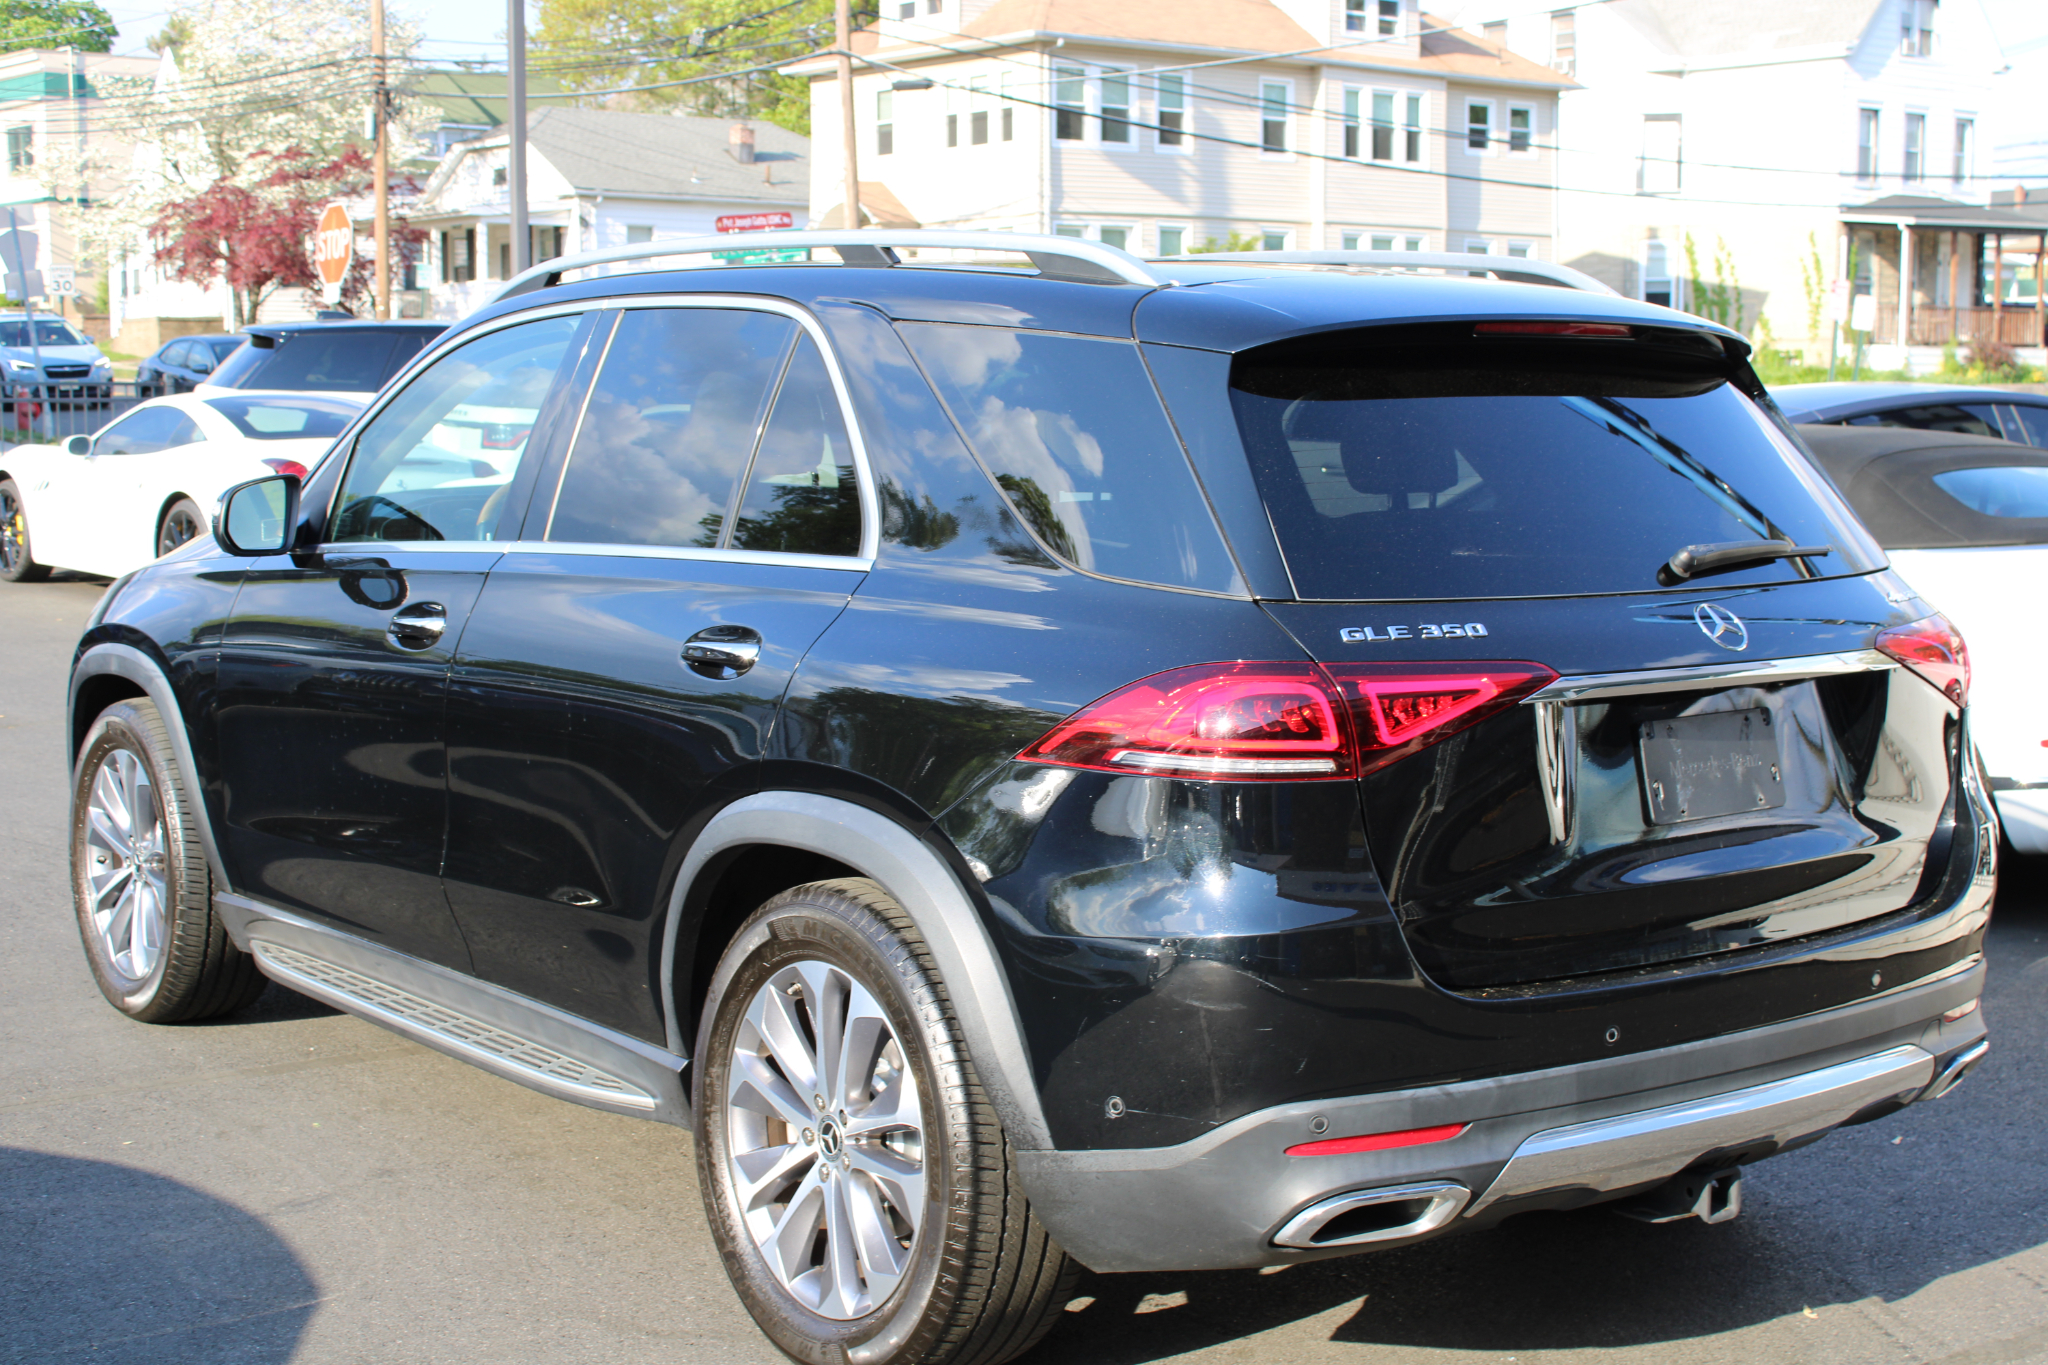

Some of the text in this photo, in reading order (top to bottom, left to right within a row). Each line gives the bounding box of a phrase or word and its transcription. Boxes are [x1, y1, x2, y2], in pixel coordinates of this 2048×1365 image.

[318, 227, 350, 262] STOP
[52, 280, 72, 292] 30
[1339, 622, 1488, 643] GLE 350
